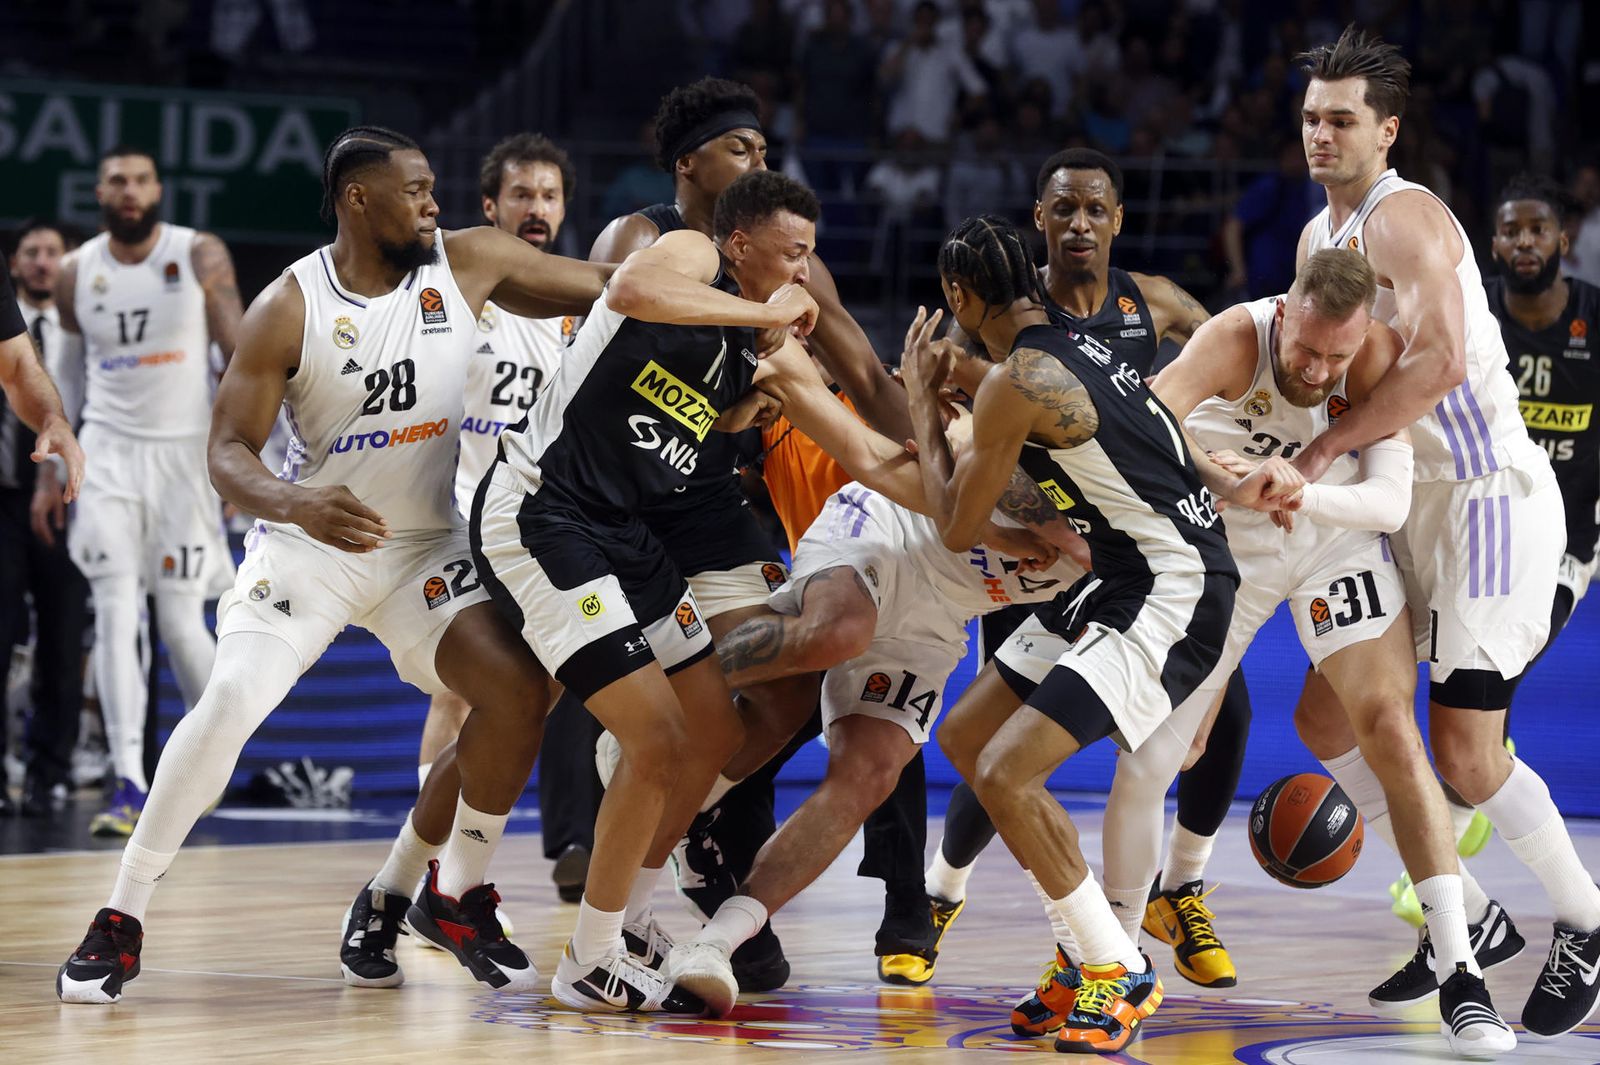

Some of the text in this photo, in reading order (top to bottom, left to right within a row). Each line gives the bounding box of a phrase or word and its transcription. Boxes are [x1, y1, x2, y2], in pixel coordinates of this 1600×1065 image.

[57, 170, 226, 228] EIT
[115, 308, 150, 346] 17
[361, 358, 417, 417] 28
[490, 361, 543, 410] 23
[1517, 354, 1552, 397] 26
[660, 436, 698, 475] NIS
[1146, 398, 1186, 467] 7
[177, 546, 204, 579] 17
[1329, 570, 1386, 627] 31
[1076, 625, 1109, 656] 7
[887, 669, 939, 733] 14
